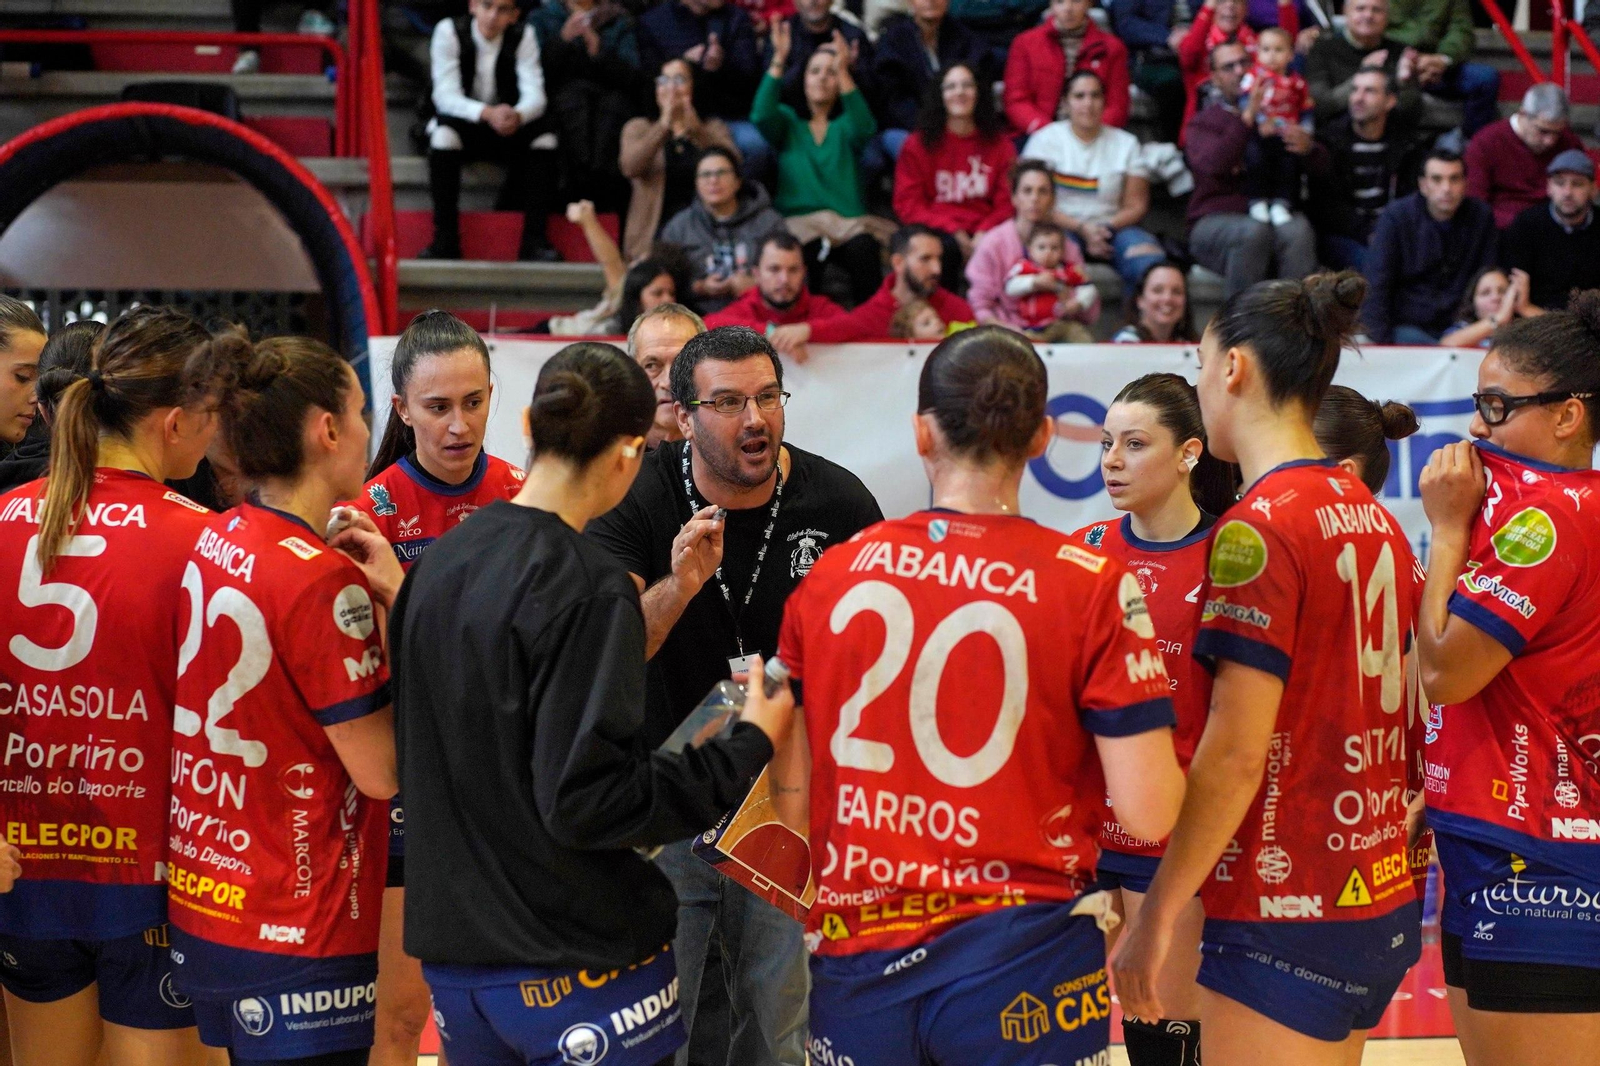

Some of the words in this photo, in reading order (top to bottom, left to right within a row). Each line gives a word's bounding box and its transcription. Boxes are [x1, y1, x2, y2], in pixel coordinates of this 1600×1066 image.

[2, 498, 147, 528] ANCA
[9, 534, 107, 671] 5
[1336, 541, 1401, 714] 14
[0, 683, 148, 721] CASASOLA
[829, 579, 1029, 788] 20
[4, 733, 145, 773] Porriño
[47, 776, 74, 795] do
[78, 777, 146, 800] Deporte
[1261, 732, 1282, 841] manprocal
[1334, 790, 1364, 825] O
[7, 821, 137, 850] ELECPOR
[291, 809, 313, 898] MARCOTE
[167, 861, 246, 910] ELECPOR
[843, 844, 1010, 889] Porriño
[1506, 904, 1521, 916] Lo
[1525, 907, 1573, 920] natural
[1577, 911, 1592, 921] es
[1275, 959, 1292, 974] es
[1293, 966, 1343, 991] dormir
[1344, 980, 1369, 996] bien
[285, 1017, 329, 1031] Vestuario
